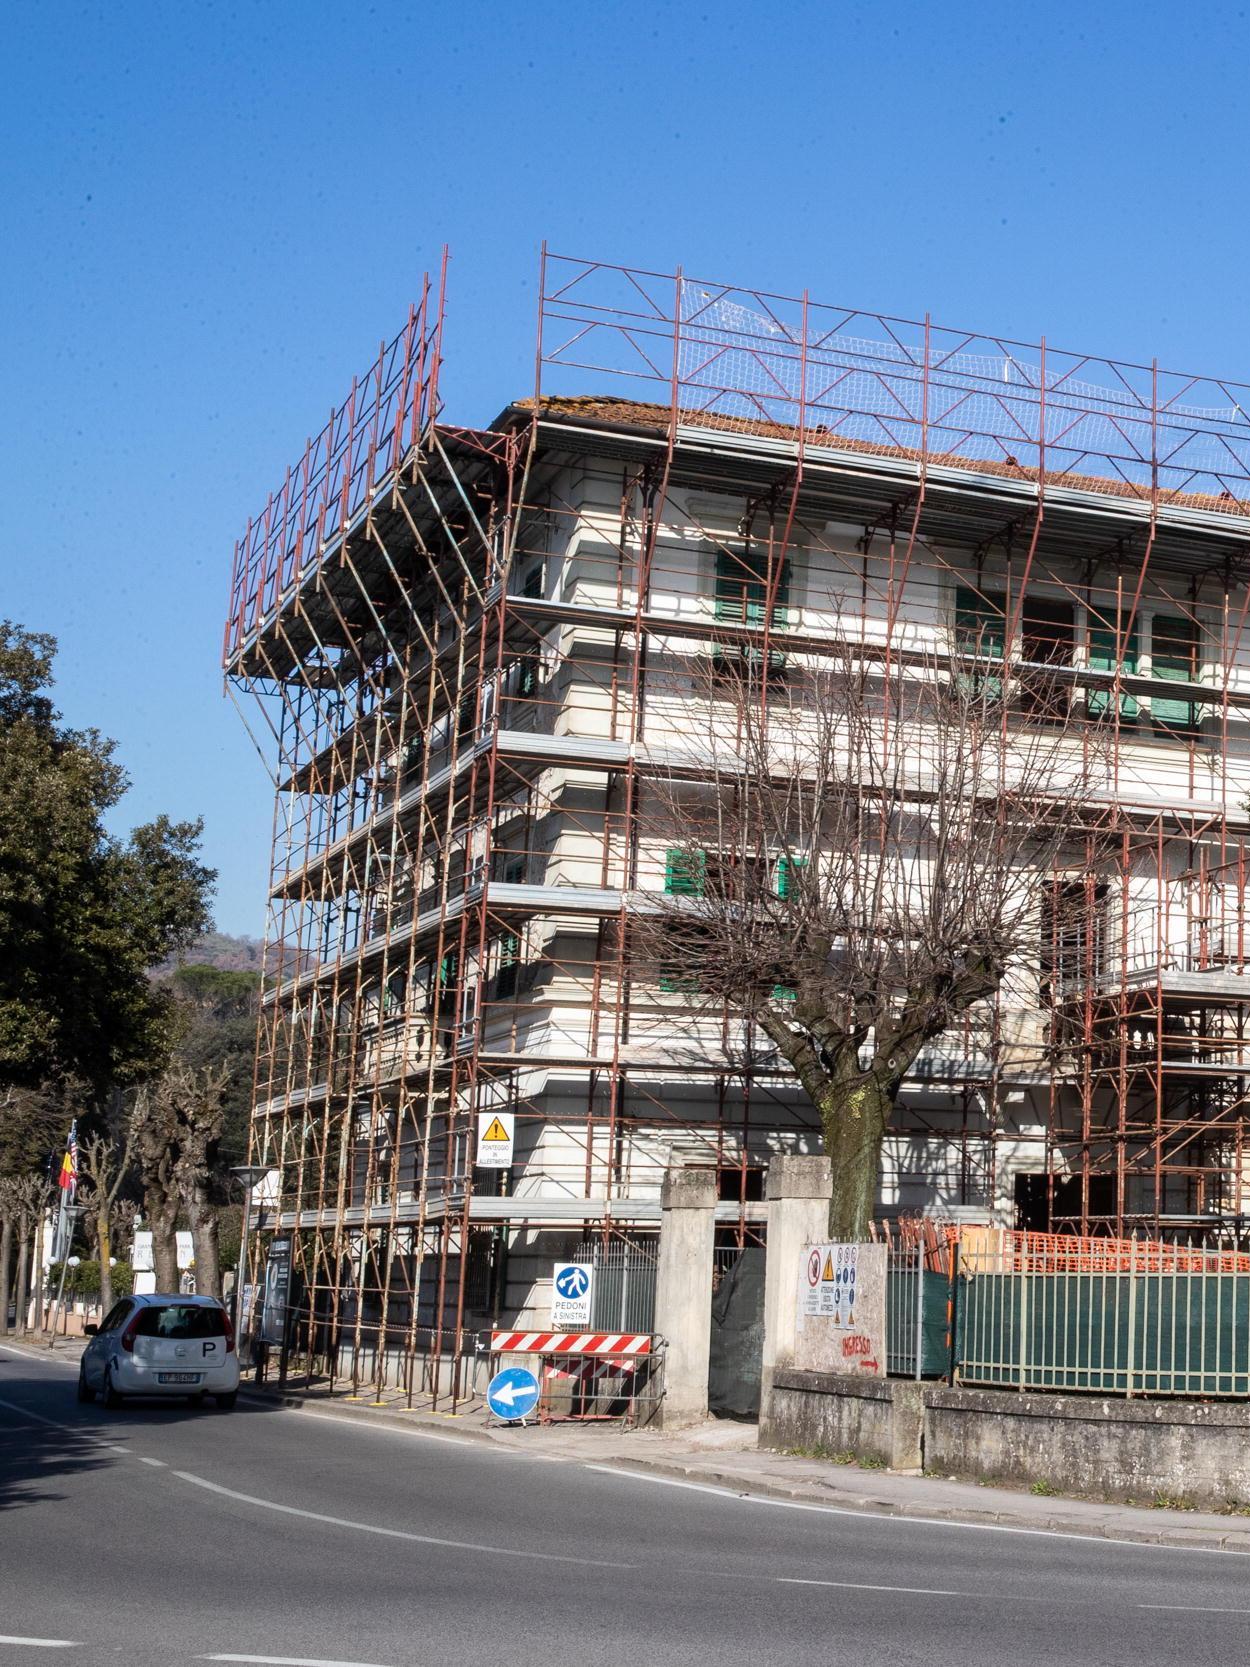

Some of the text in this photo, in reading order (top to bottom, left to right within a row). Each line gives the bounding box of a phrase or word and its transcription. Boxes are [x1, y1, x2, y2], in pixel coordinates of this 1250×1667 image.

[555, 1301, 587, 1310] PEDONI
[553, 1312, 587, 1320] A SINISTRA
[202, 1342, 216, 1357] P
[842, 1335, 871, 1357] INGRESSO
